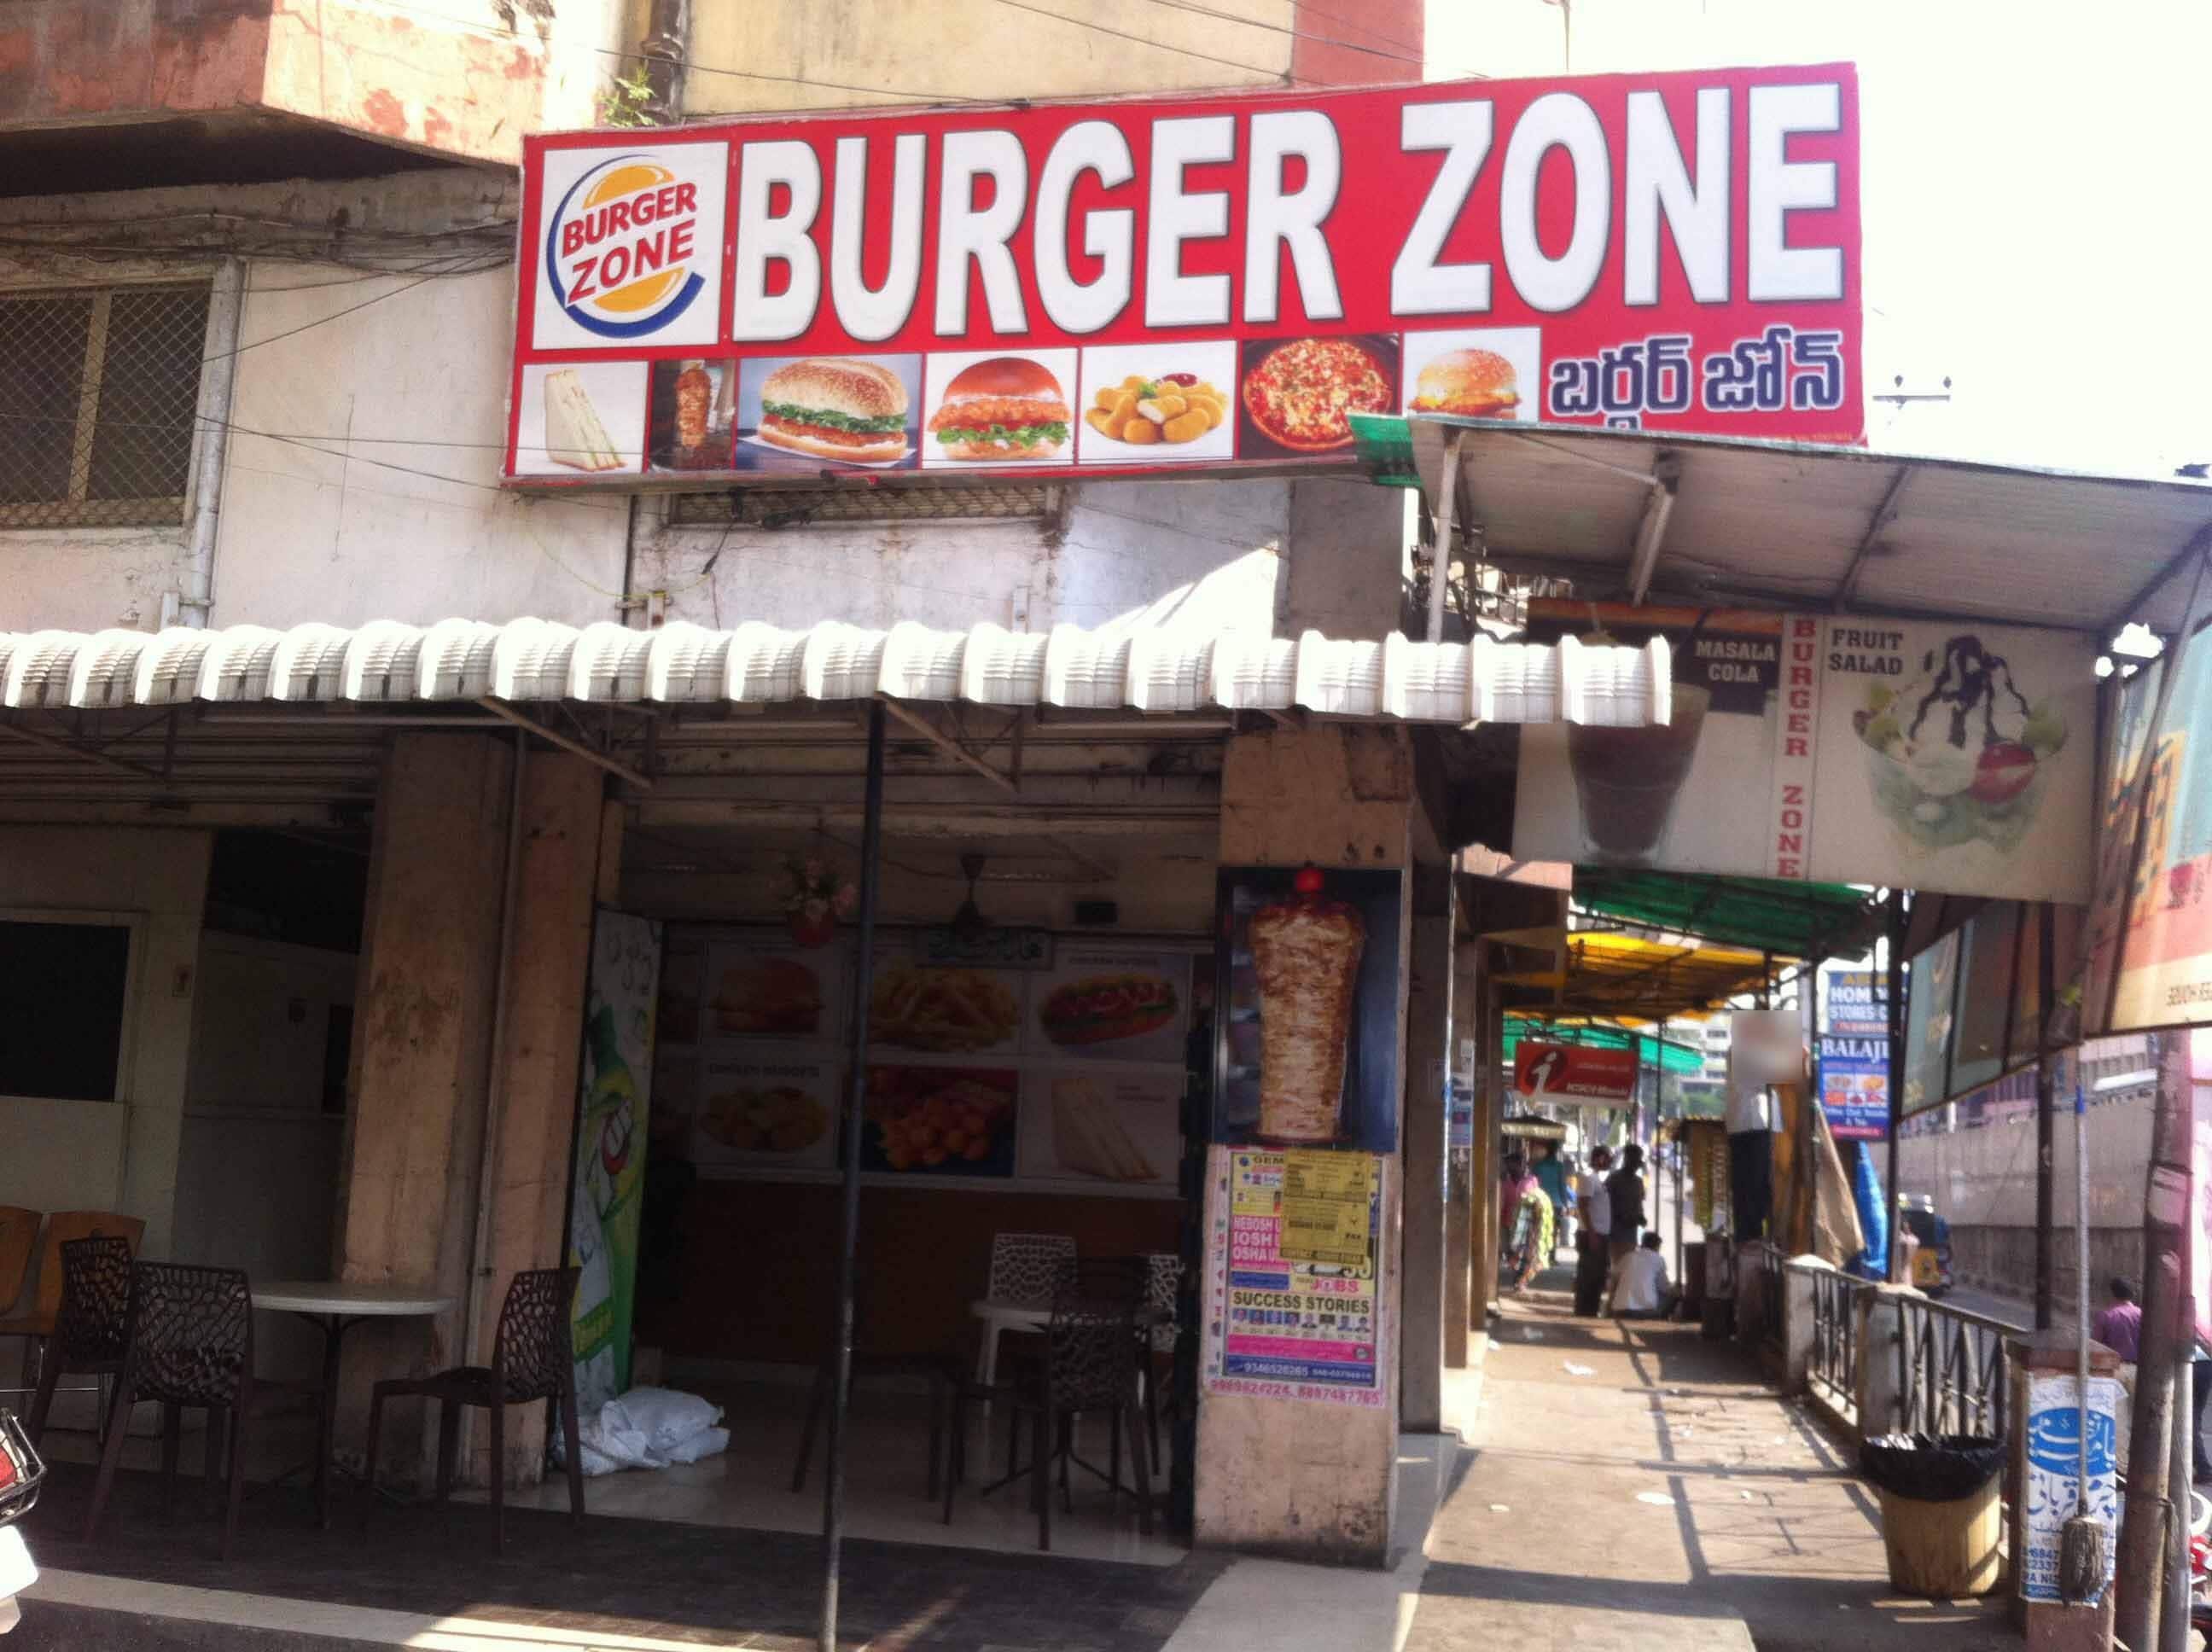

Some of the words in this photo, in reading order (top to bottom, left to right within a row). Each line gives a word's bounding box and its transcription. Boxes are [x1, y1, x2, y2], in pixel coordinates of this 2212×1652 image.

[562, 179, 697, 259] BURGER
[732, 109, 1344, 341] BURGER
[1389, 81, 1844, 317] ZONE
[566, 218, 696, 308] ZONE
[1703, 324, 1844, 411] జోన్
[1695, 641, 1776, 661] MASALA
[1828, 653, 1903, 676] SALAD
[1831, 628, 1904, 650] FRUIT
[1708, 663, 1761, 683] COLA
[1784, 619, 1816, 758] BURGER
[1777, 785, 1804, 879] ZONE
[1821, 1038, 1889, 1064] BALAJI
[1233, 1291, 1301, 1309] SUCCESS
[1306, 1294, 1370, 1315] STORIES
